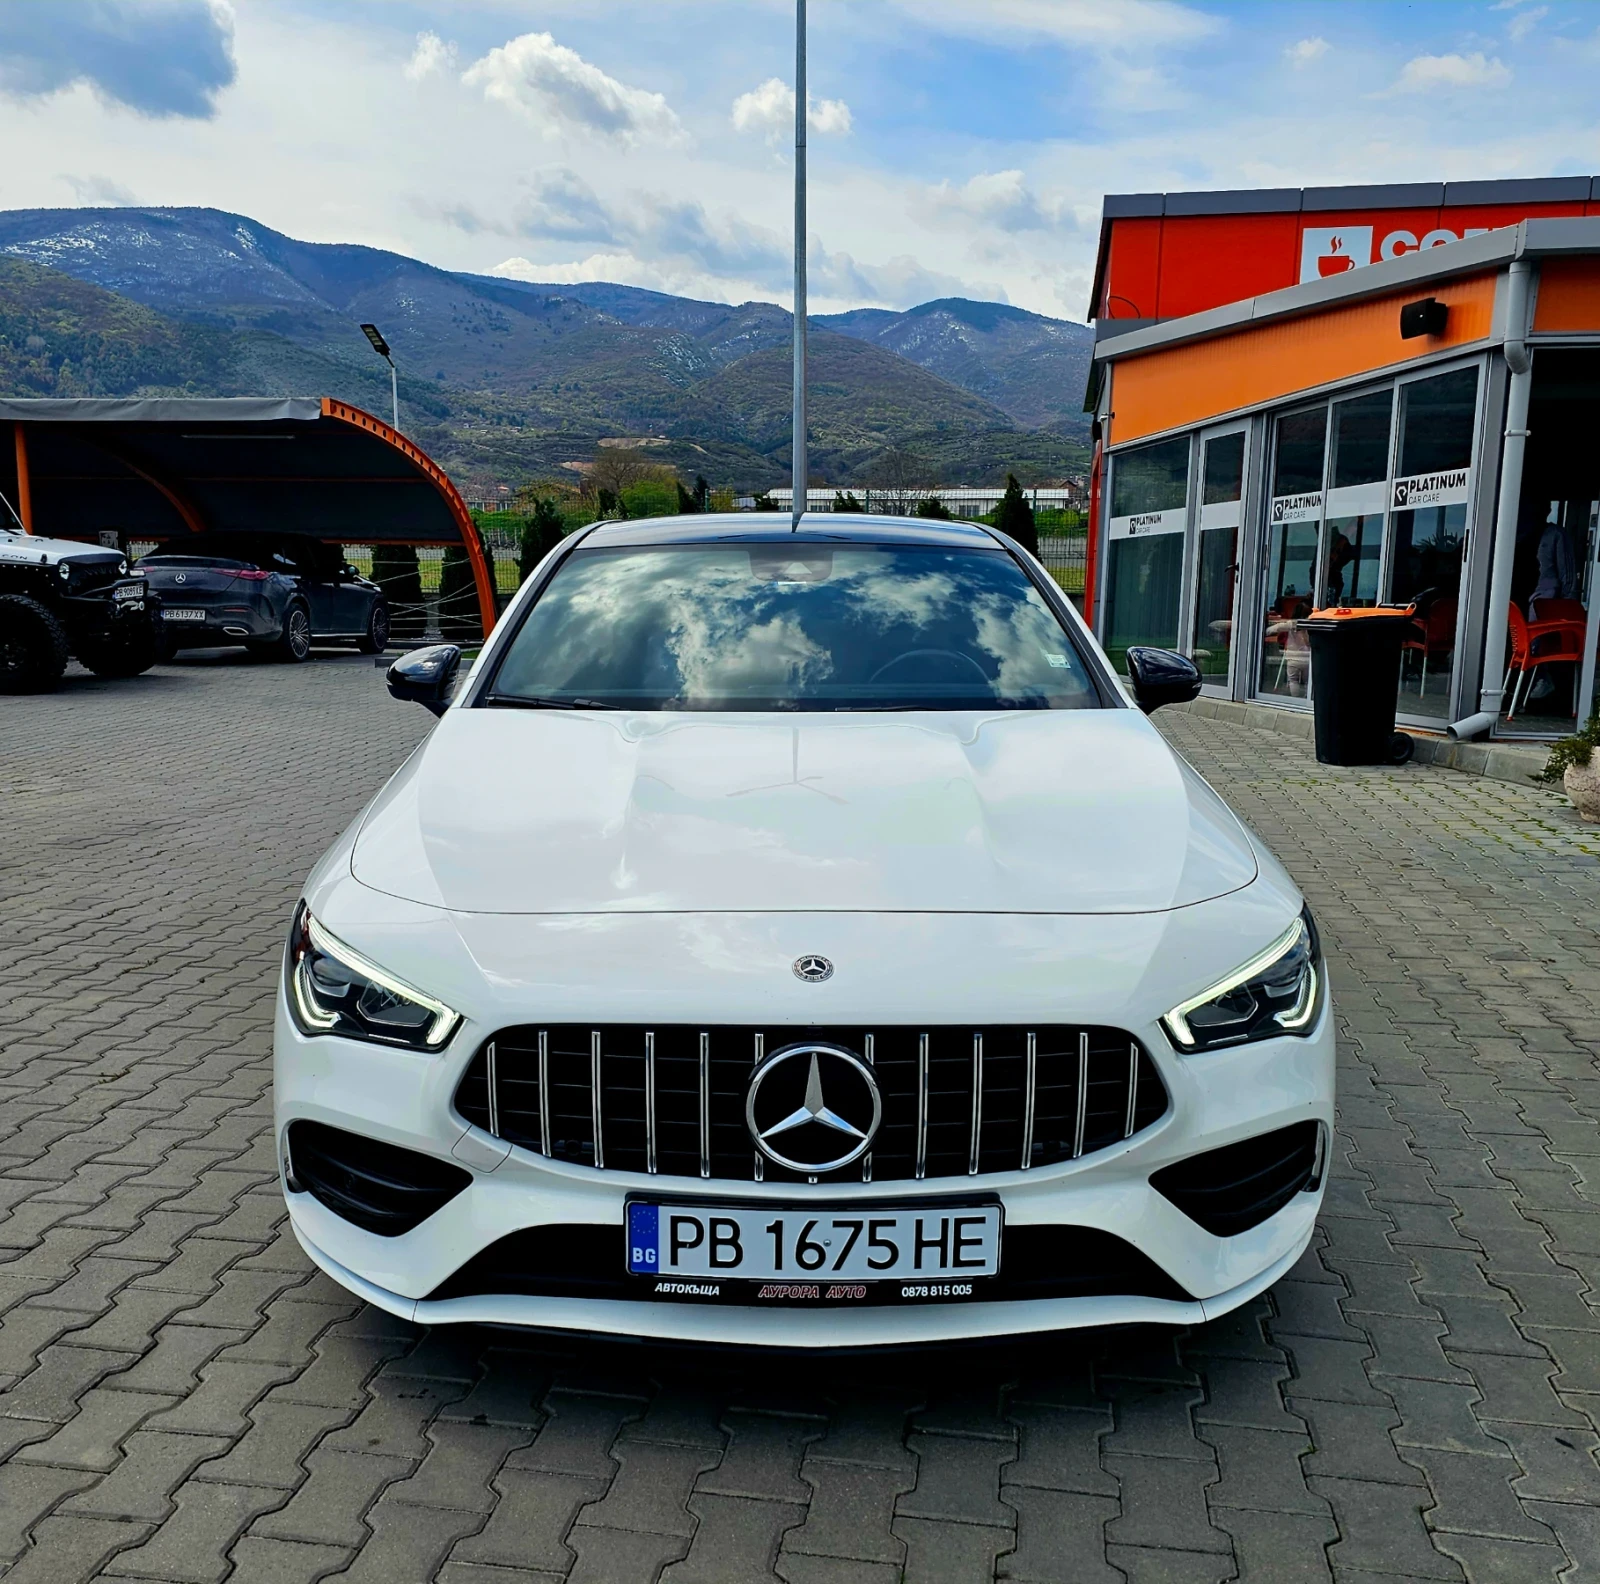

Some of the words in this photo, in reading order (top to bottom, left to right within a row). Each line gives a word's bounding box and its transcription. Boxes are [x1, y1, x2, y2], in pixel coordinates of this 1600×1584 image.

[1409, 472, 1466, 493] PLATINUM
[1408, 496, 1421, 505] CAR
[1423, 493, 1440, 503] CARE
[165, 610, 175, 618] PB
[175, 610, 193, 618] 6137
[194, 610, 204, 618] XX
[670, 1215, 744, 1269] PB
[766, 1219, 900, 1271] 1675
[913, 1216, 987, 1270] HE
[632, 1247, 656, 1263] BG
[654, 1282, 720, 1296] АВТОКЪЩА
[758, 1285, 819, 1298] АУРОРА
[826, 1285, 867, 1298] АУТО
[901, 1286, 928, 1297] 0878
[930, 1285, 950, 1296] 815
[952, 1284, 972, 1295] 005
